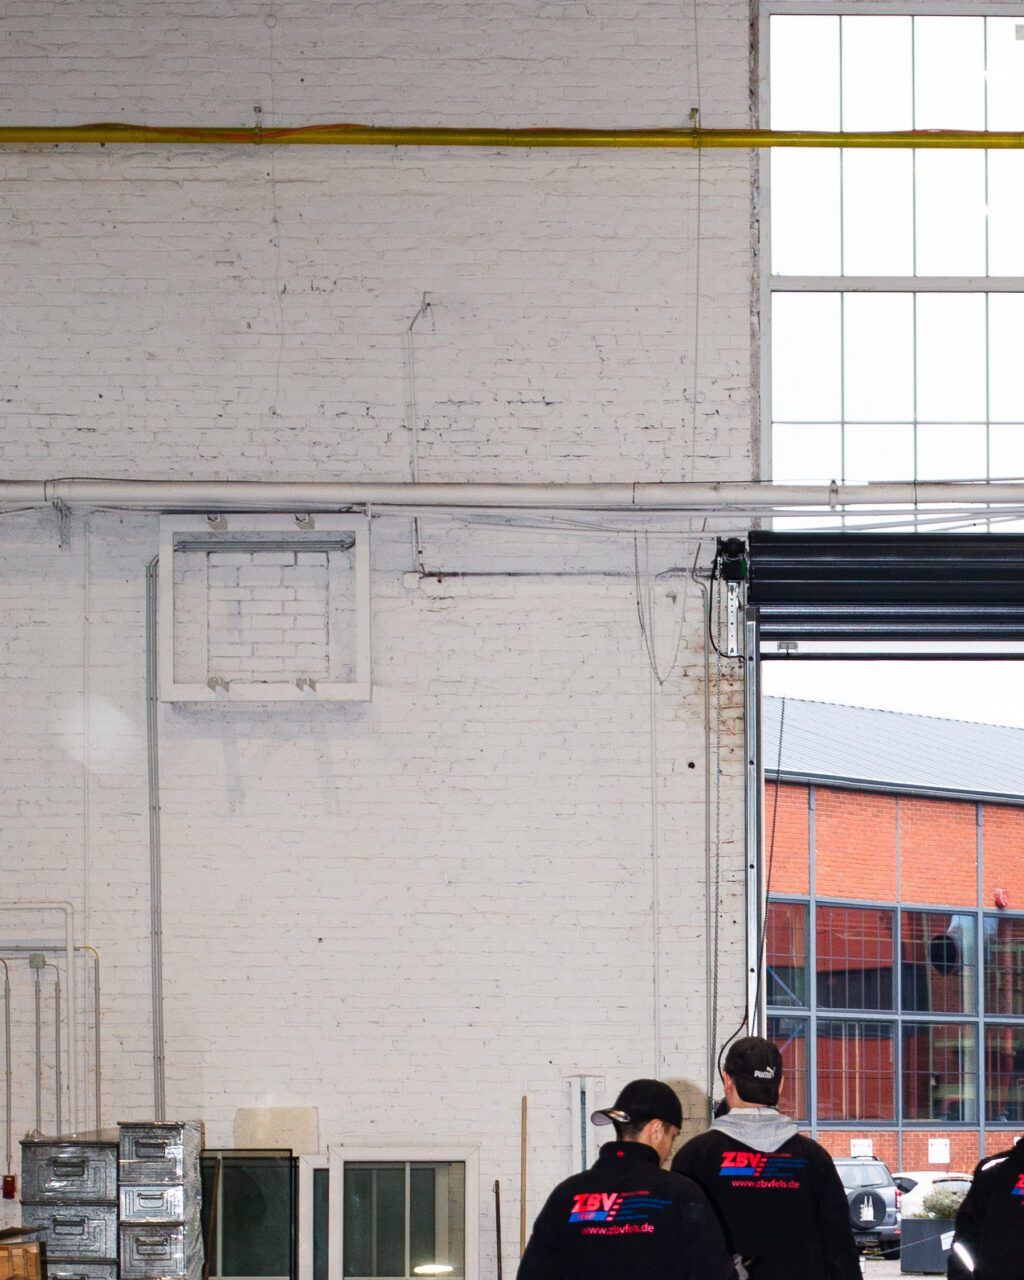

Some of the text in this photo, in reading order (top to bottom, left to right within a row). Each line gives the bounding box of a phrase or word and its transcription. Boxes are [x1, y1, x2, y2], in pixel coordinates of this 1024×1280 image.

[720, 1152, 762, 1168] ZBV
[731, 1180, 800, 1189] www.zbvfels.de
[570, 1193, 619, 1213] ZBV
[582, 1222, 655, 1235] www.zbvfels.de
